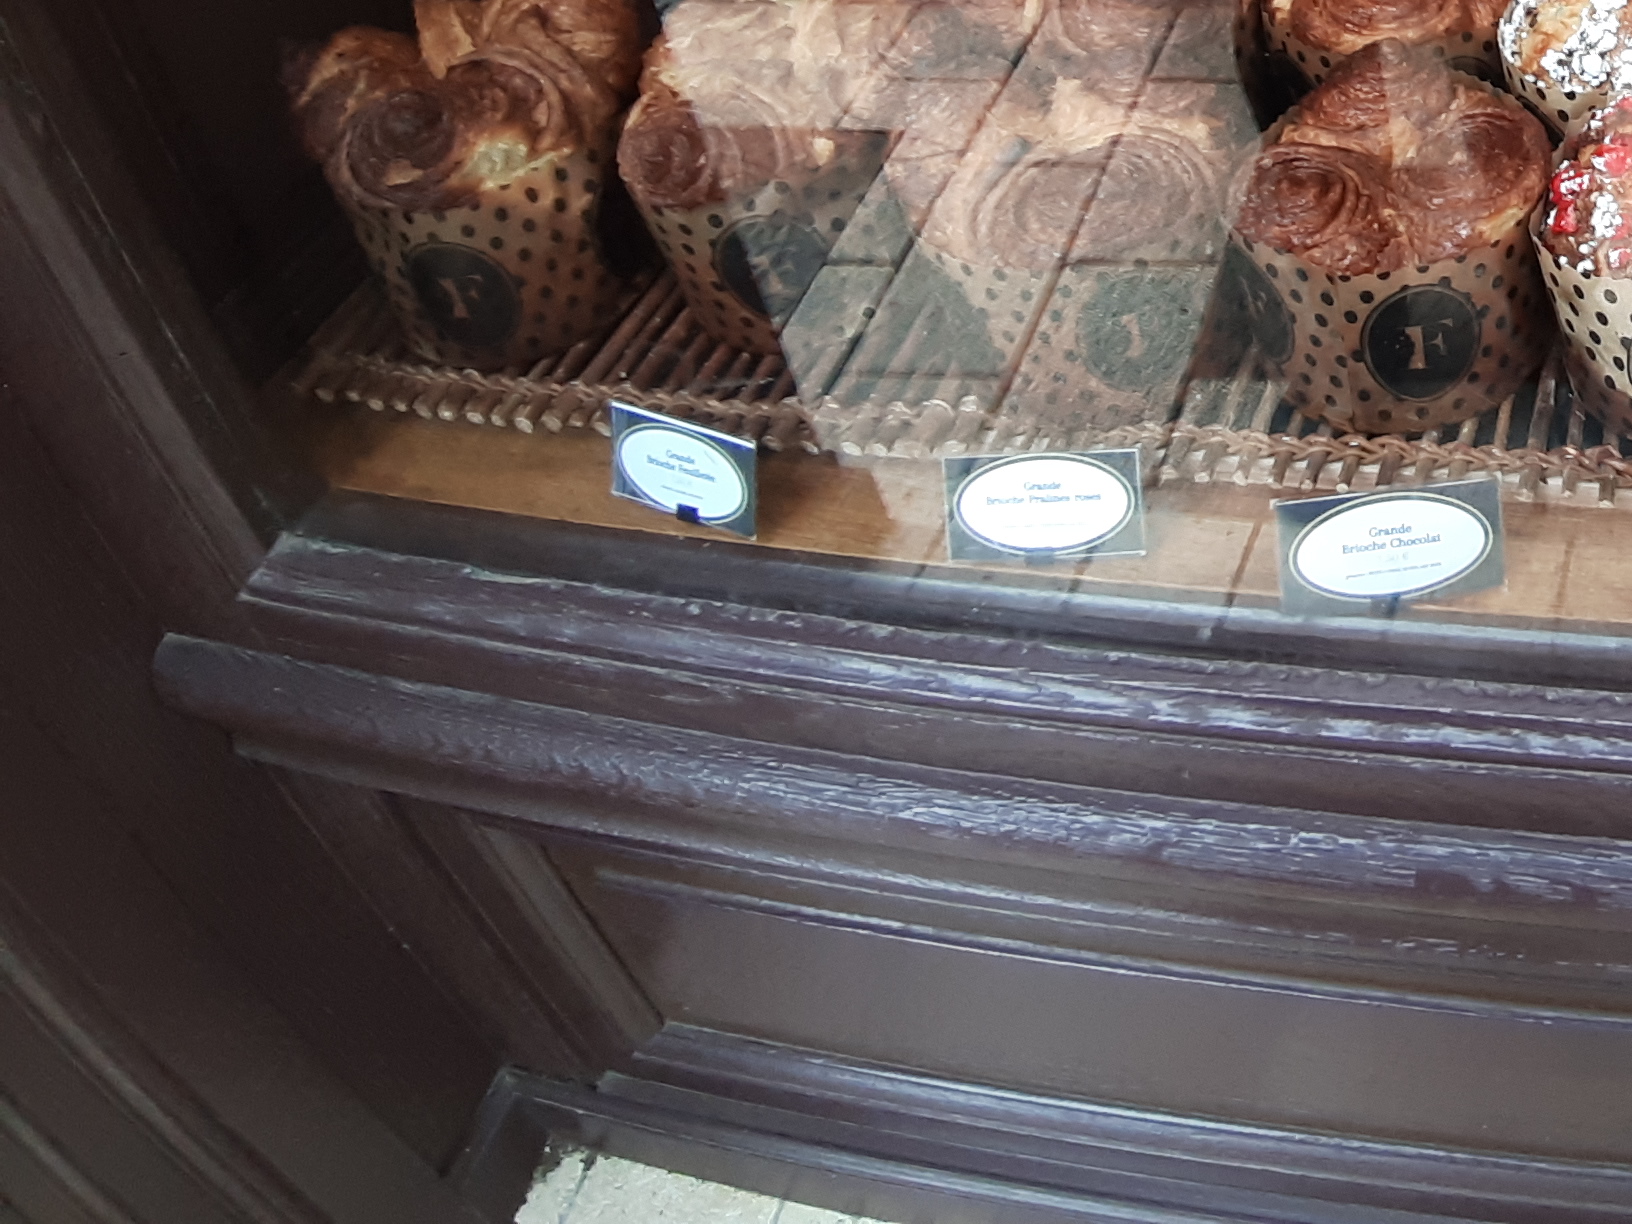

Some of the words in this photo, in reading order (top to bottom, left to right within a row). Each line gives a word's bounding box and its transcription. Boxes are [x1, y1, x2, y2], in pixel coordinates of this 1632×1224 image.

[1403, 317, 1454, 371] F
[1023, 481, 1061, 491] Grande
[986, 496, 1025, 505] Brioche
[1368, 523, 1412, 538] Grande
[1342, 540, 1387, 554] Brioche
[1389, 533, 1442, 549] Chocolat
